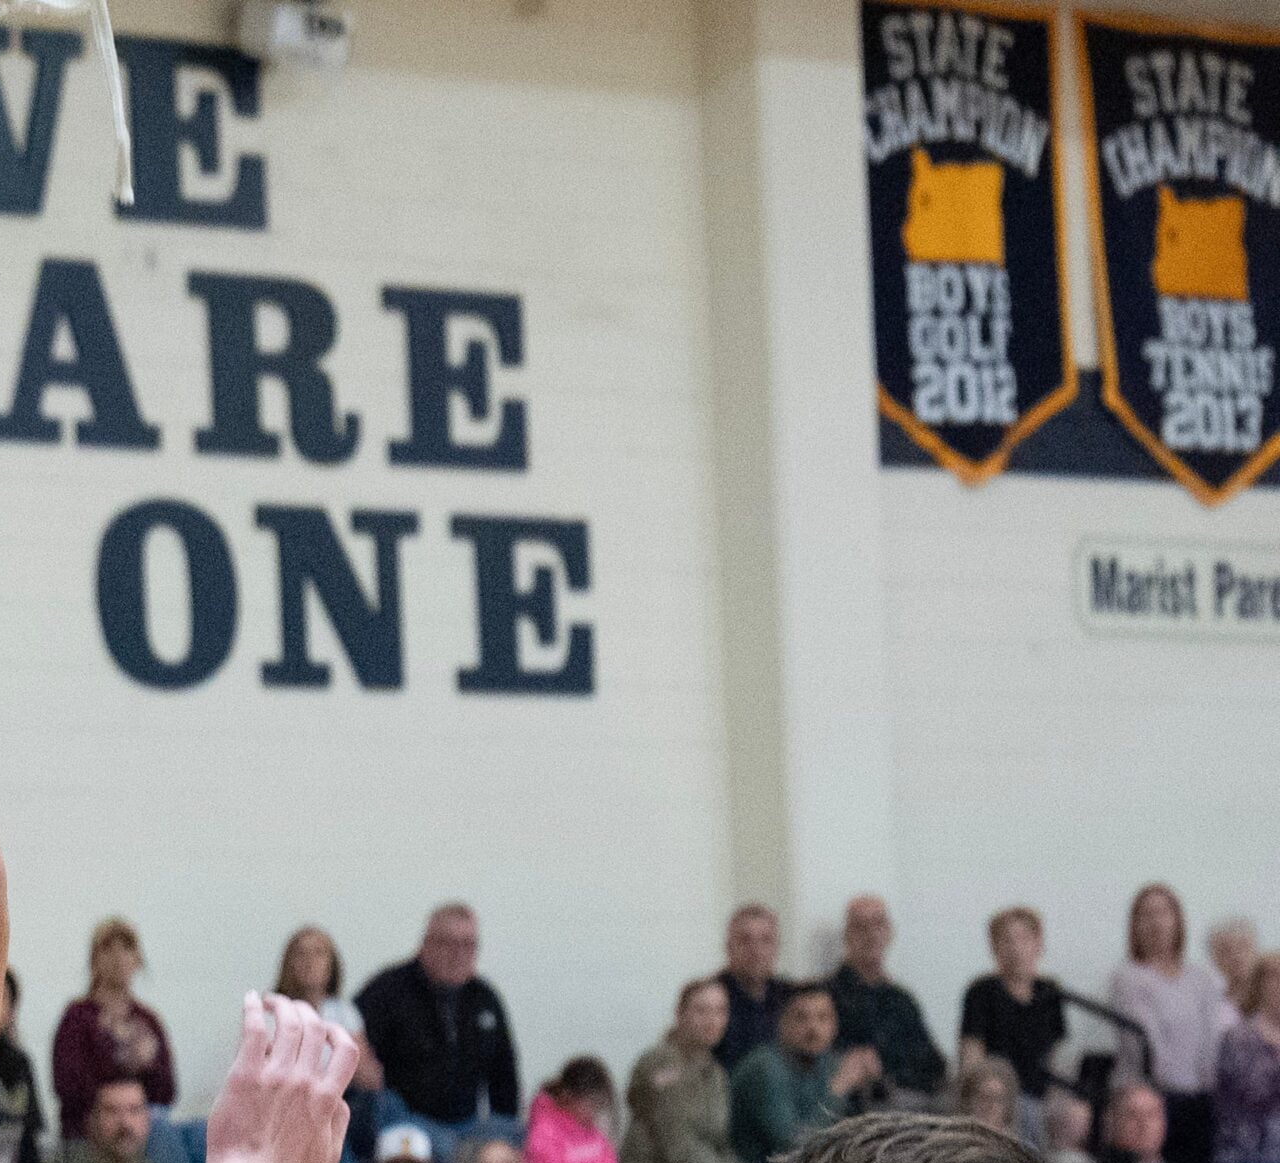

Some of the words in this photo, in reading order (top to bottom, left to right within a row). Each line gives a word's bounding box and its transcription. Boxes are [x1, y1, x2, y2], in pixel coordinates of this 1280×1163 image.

[881, 13, 1015, 90] STATE
[1123, 49, 1254, 126] STATE
[904, 261, 1011, 317] BOYS
[907, 314, 1014, 365] GOLF
[1157, 293, 1258, 348] BOYS
[912, 361, 1020, 426] 2012
[1141, 341, 1276, 397] TENNIS
[1161, 392, 1265, 451] 2013
[95, 497, 596, 698] ONE
[1088, 555, 1199, 621] Marist
